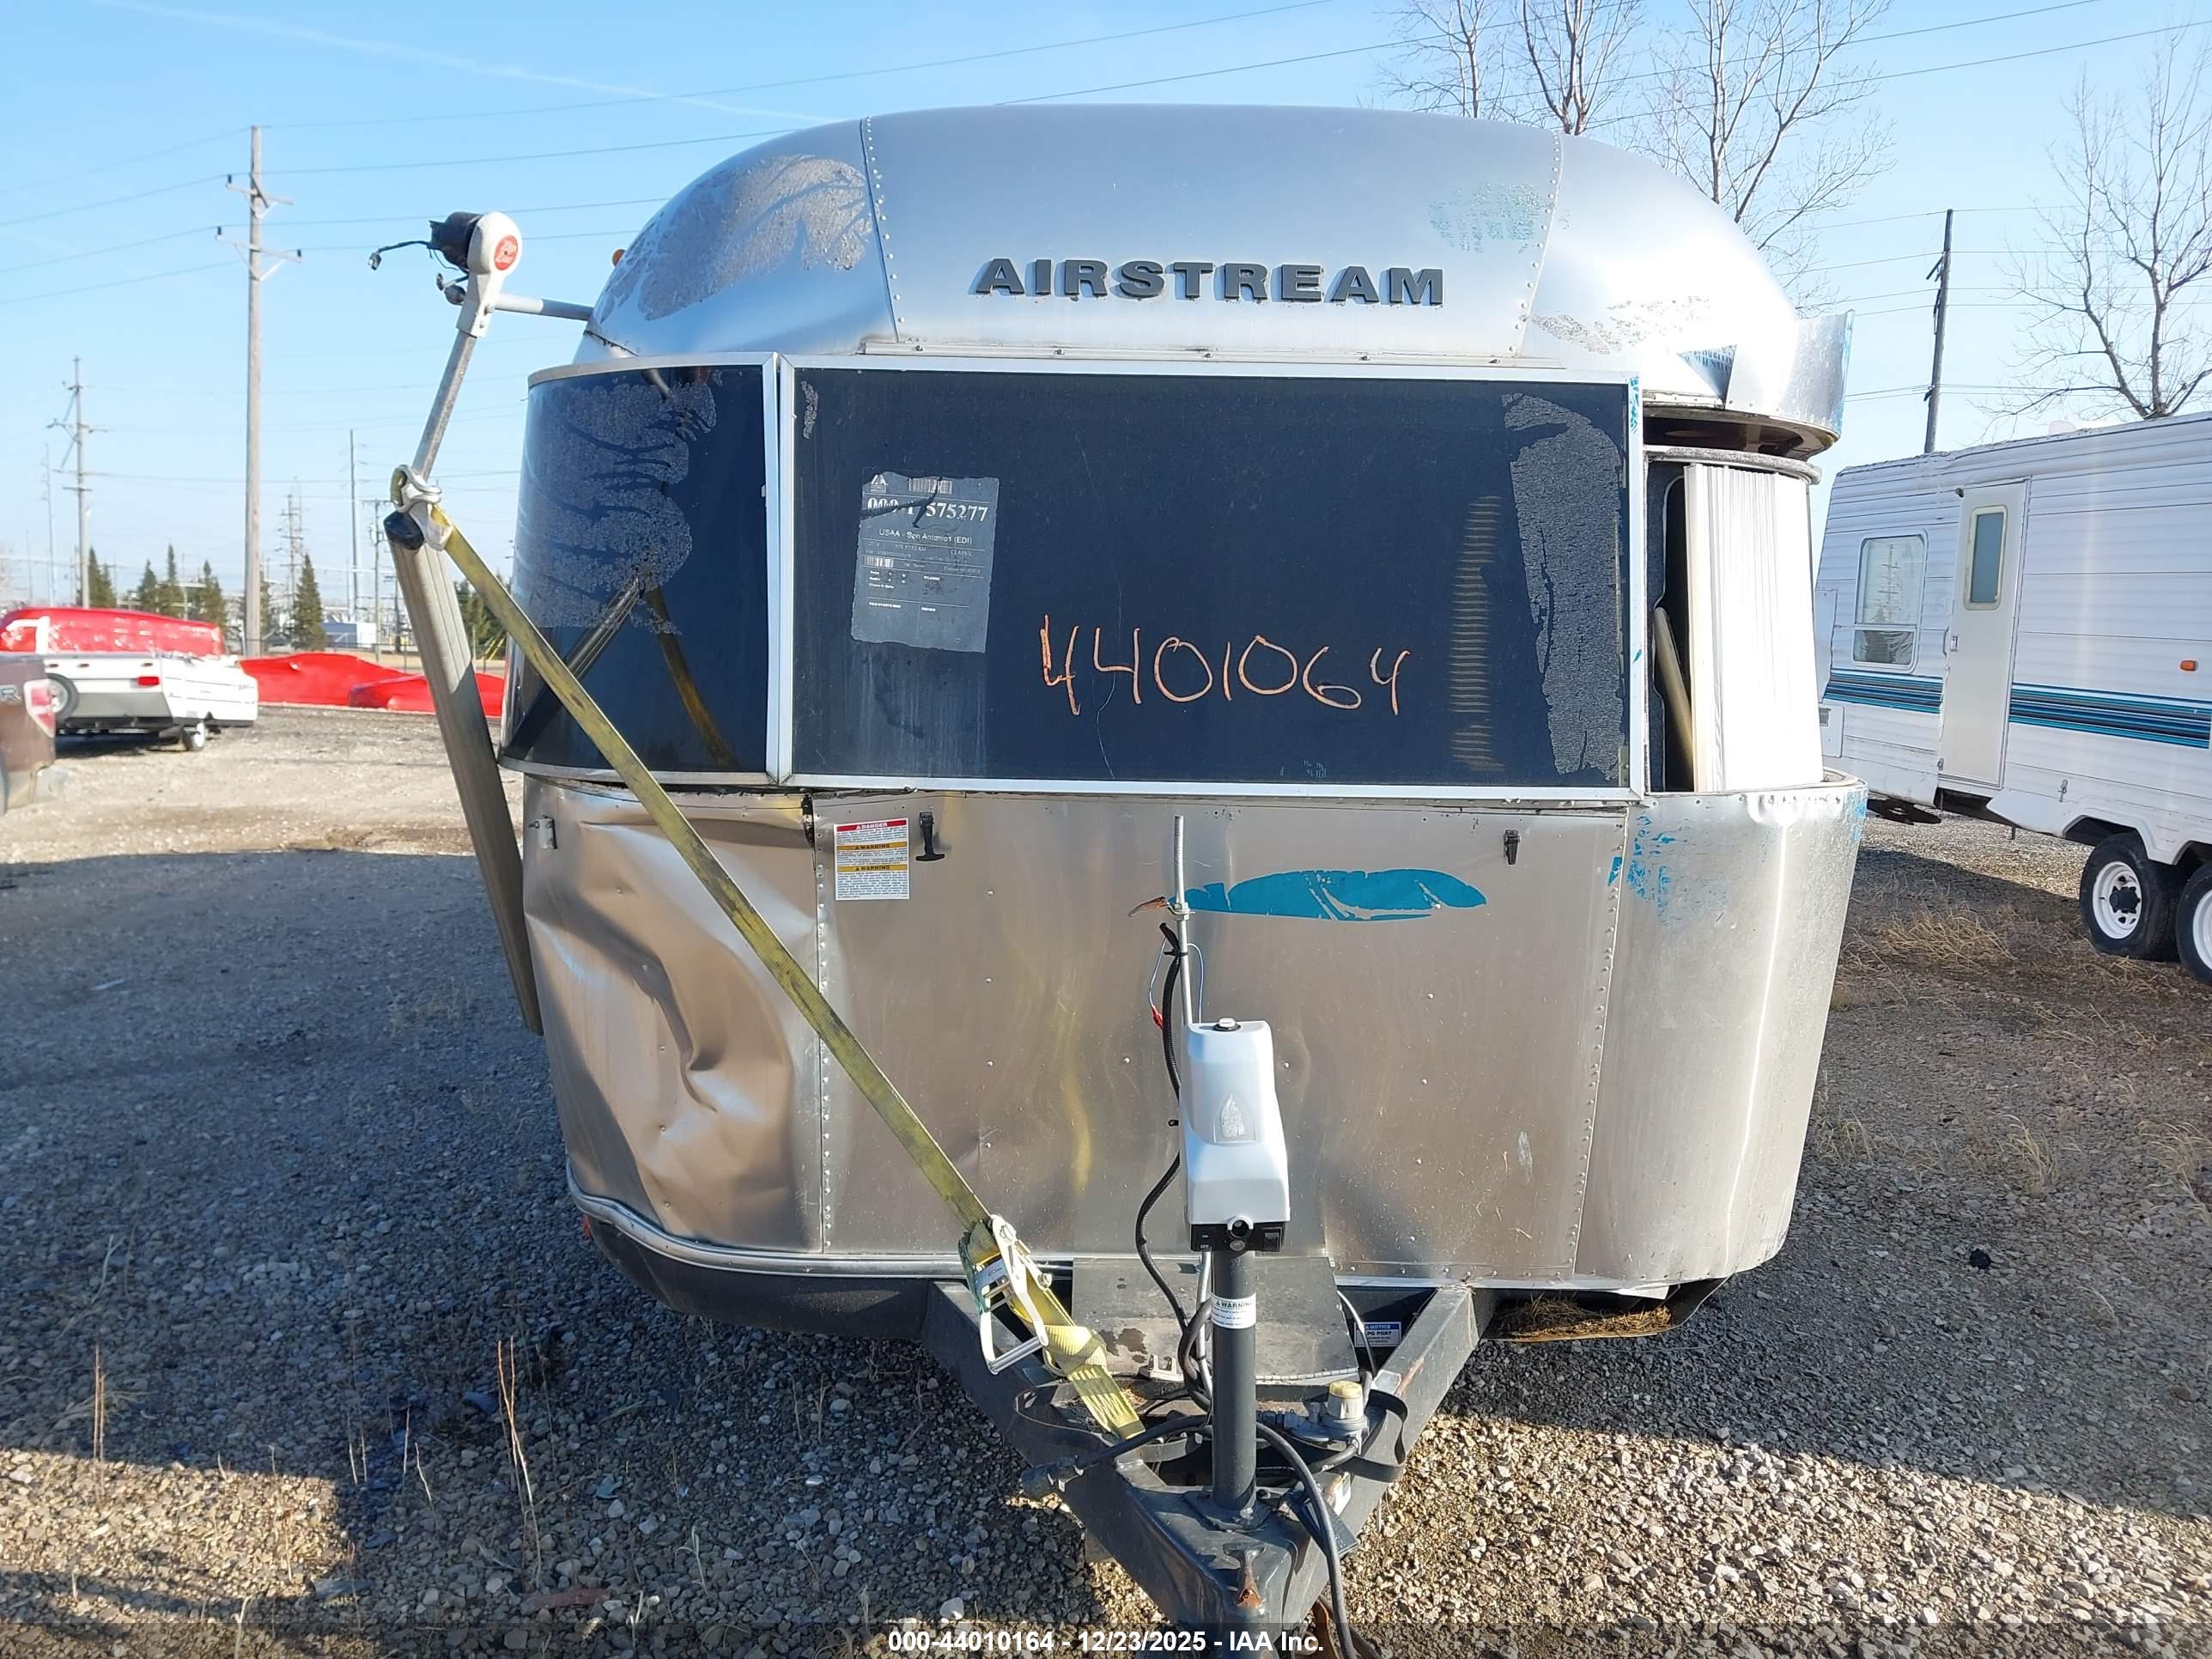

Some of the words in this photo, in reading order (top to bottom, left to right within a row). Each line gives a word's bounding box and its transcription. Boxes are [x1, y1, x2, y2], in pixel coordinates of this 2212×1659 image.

[975, 258, 1443, 307] AIRSTREAM
[878, 528, 901, 538] USAA
[954, 533, 973, 545] (EDI)
[1039, 613, 1413, 716] 4401064
